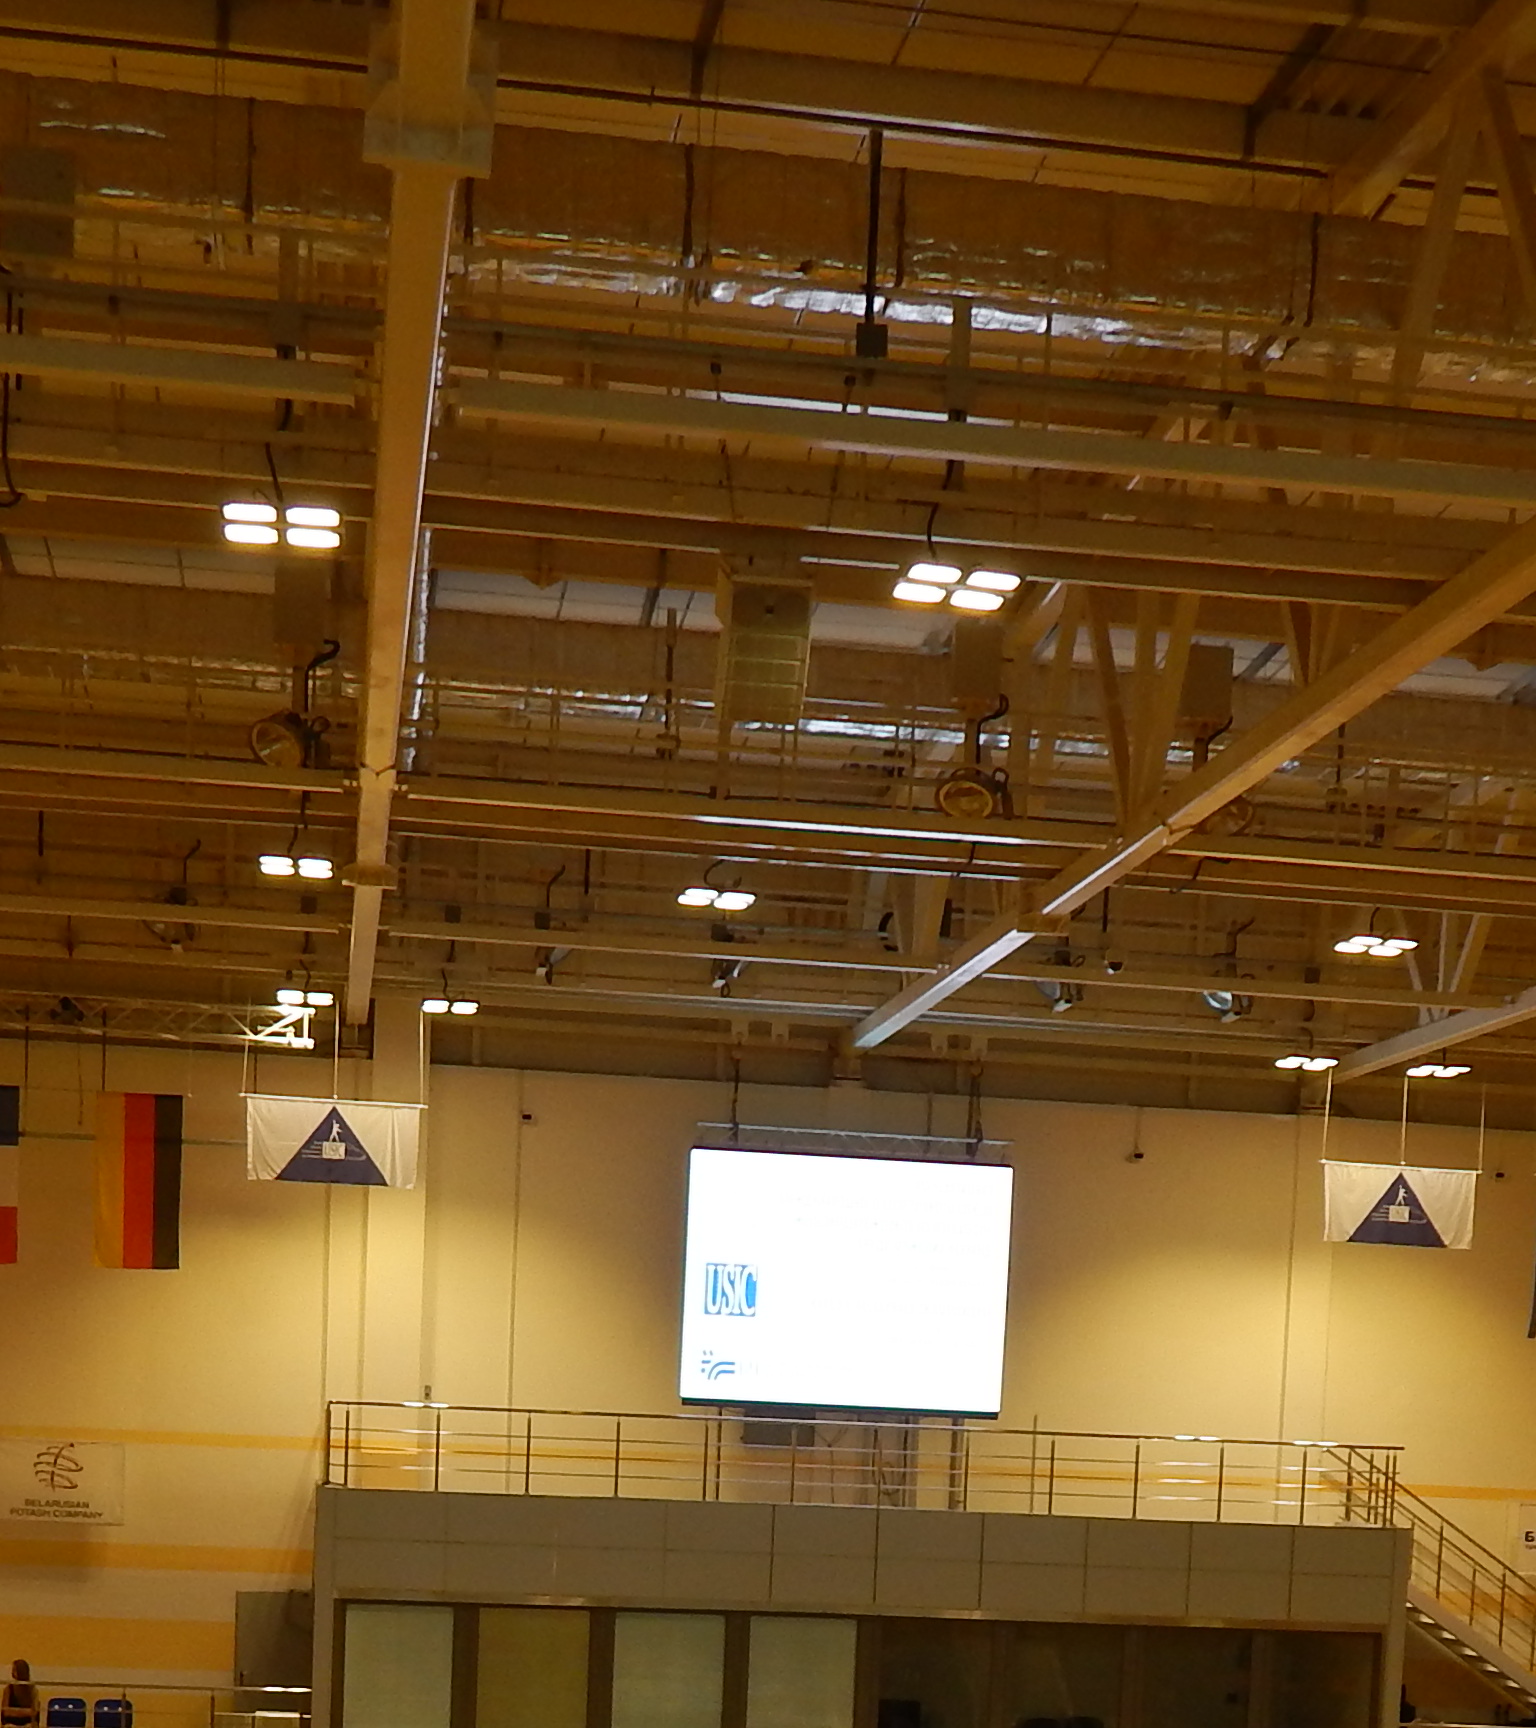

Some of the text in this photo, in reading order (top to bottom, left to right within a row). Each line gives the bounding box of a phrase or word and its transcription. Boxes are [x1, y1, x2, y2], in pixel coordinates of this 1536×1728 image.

[705, 1264, 759, 1316] USIC
[24, 1498, 90, 1508] BELARUSIAN
[10, 1508, 103, 1519] POTASH COMPANY
